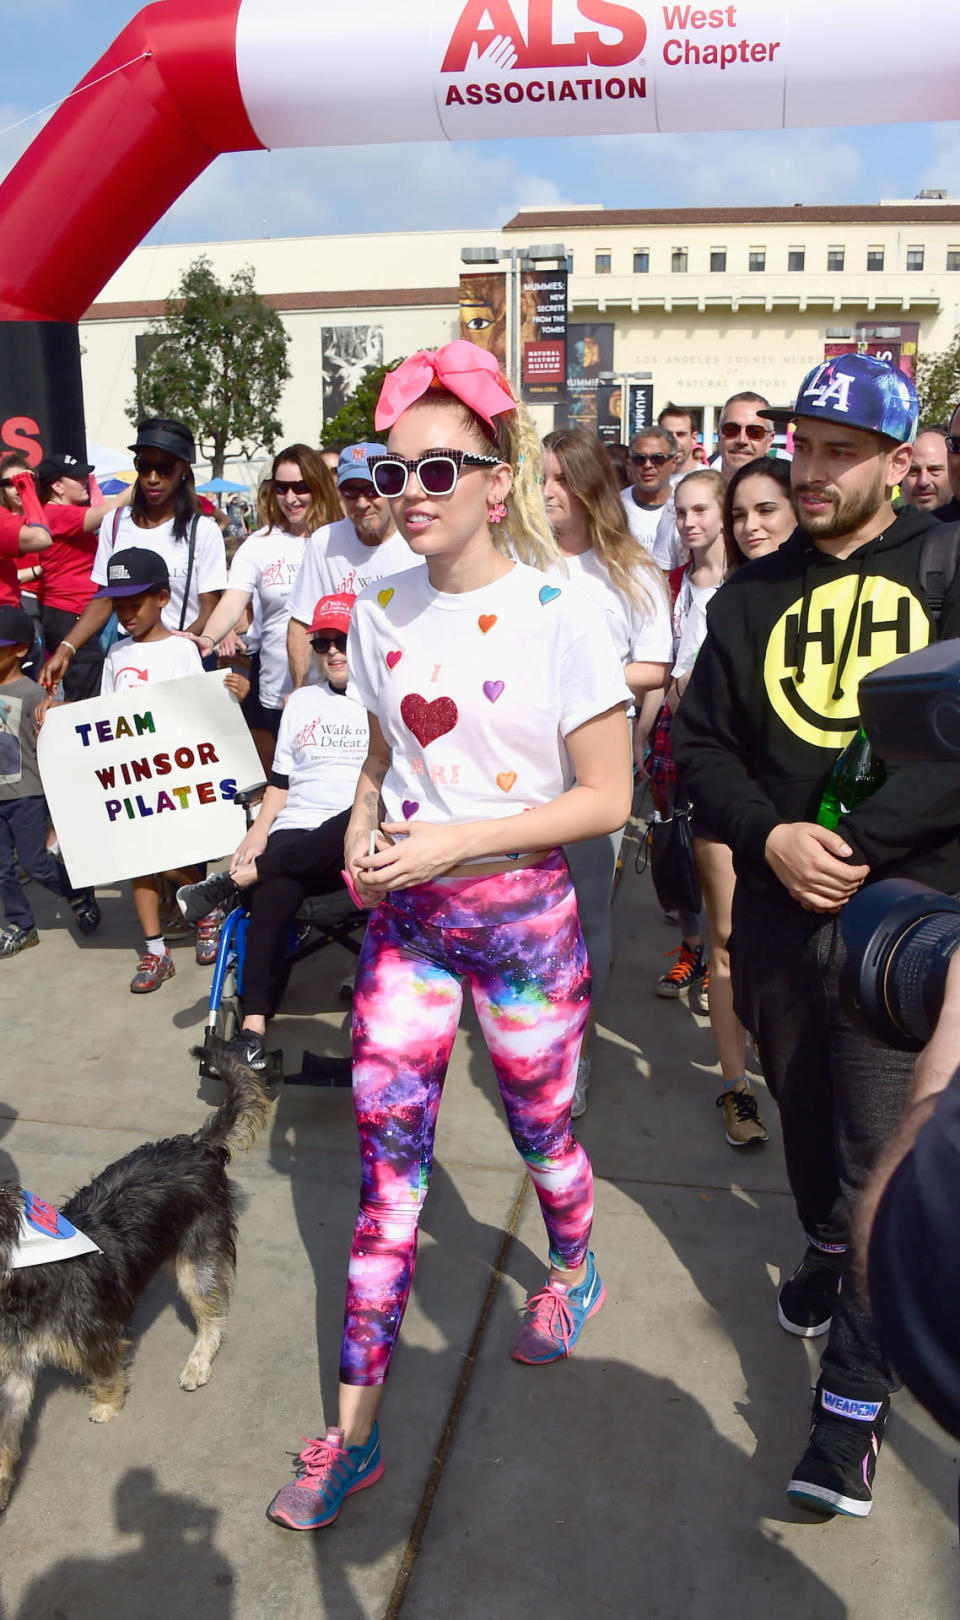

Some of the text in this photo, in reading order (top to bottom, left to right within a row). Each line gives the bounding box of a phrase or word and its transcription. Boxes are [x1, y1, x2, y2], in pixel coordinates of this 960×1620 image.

[662, 4, 737, 30] West
[440, 0, 647, 73] ALS
[662, 38, 780, 69] Chapter
[445, 77, 647, 106] ASSOCIATION
[524, 282, 565, 290] MUMMIES:
[532, 315, 552, 323] FROM
[635, 355, 658, 364] LOS
[665, 355, 719, 364] ANGELES
[727, 355, 775, 364] COUNTY
[803, 362, 855, 412] LA
[75, 711, 155, 746] TEAM
[321, 724, 351, 735] Walk
[321, 736, 360, 748] Defeat
[95, 742, 219, 790] WINSOR
[105, 778, 237, 822] PILATES
[824, 1391, 879, 1417] WEAPON
